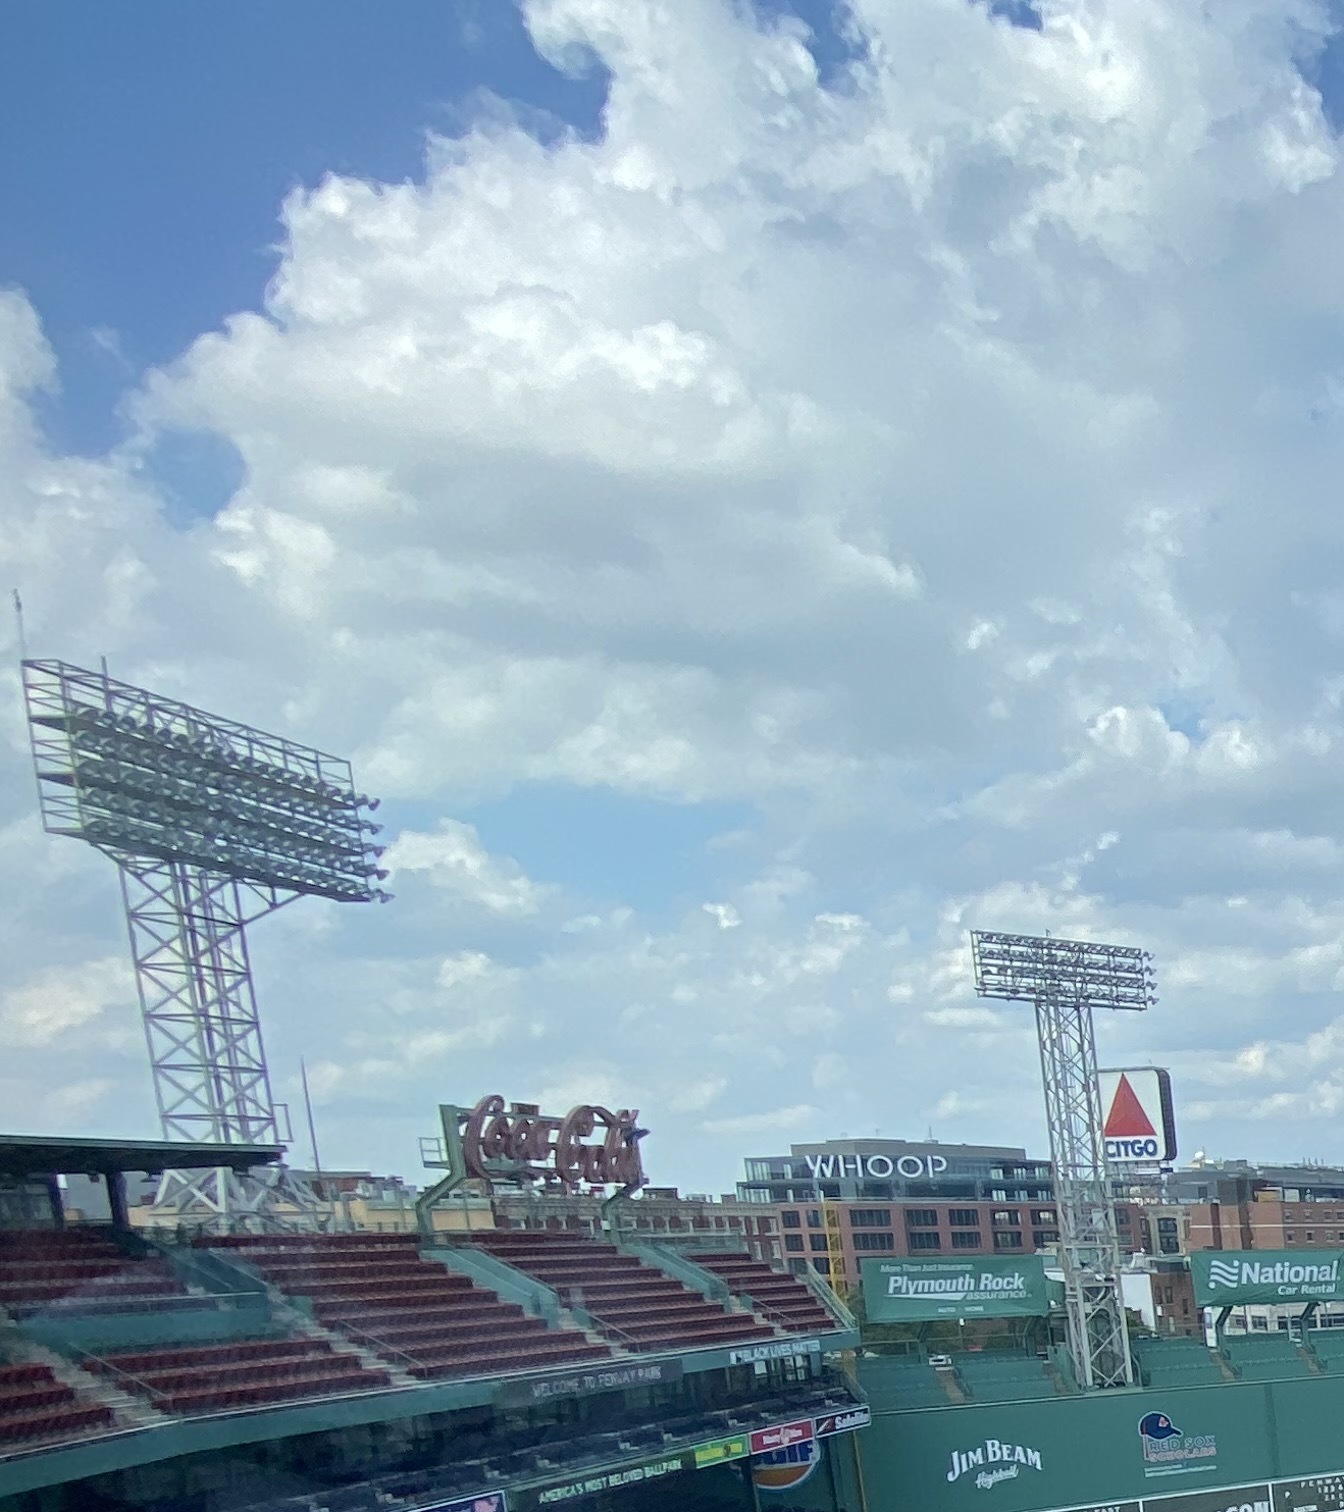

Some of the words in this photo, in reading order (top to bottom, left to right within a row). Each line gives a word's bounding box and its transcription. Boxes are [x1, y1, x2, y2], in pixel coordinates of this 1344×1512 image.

[1105, 1139, 1158, 1157] CITGO
[804, 1154, 947, 1179] WHOOP
[1241, 1260, 1339, 1284] National
[888, 1273, 975, 1296] Plymouth
[978, 1272, 1025, 1291] Rock
[1278, 1285, 1298, 1295] Car
[1301, 1283, 1336, 1295] Rental
[770, 1343, 792, 1357] LIVES
[533, 1378, 579, 1398] WELCOME
[584, 1375, 595, 1389] TO
[1149, 1438, 1181, 1452] RED
[1184, 1435, 1217, 1449] SOX
[947, 1447, 984, 1482] JIM
[985, 1439, 1043, 1471] BEAM
[539, 1482, 584, 1504] AMERICA'S
[584, 1477, 607, 1493] MOST
[608, 1468, 644, 1487] BELOVED
[645, 1458, 682, 1478] BALLPARK
